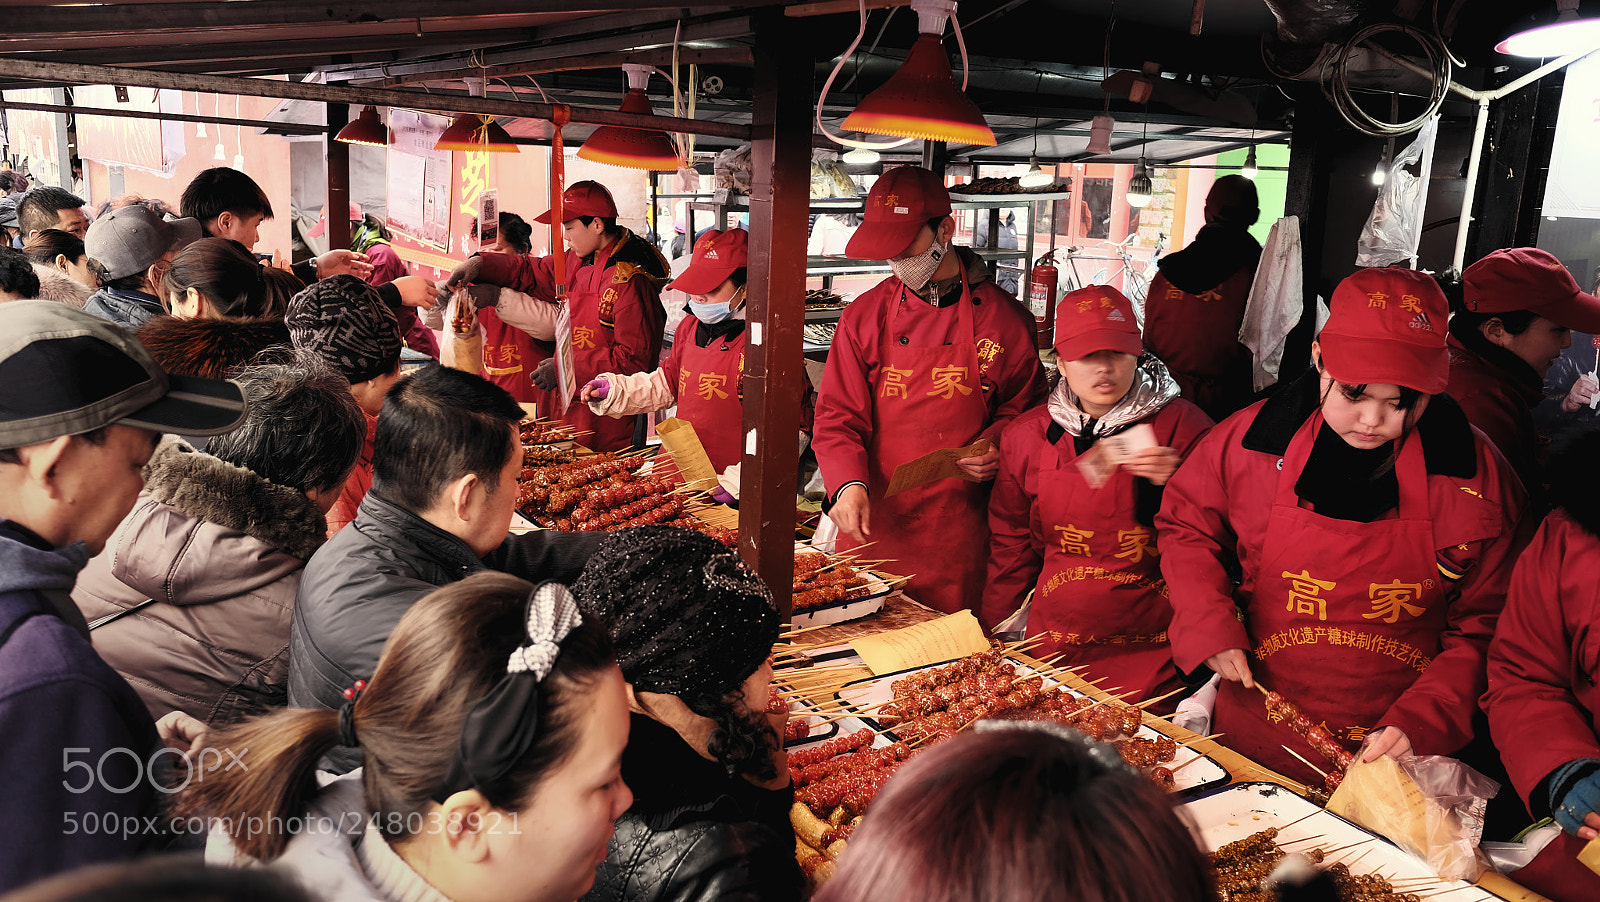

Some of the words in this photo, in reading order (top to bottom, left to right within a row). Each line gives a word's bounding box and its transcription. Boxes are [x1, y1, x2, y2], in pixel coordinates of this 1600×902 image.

[1367, 292, 1422, 313] 高家
[881, 363, 973, 400] 高家
[1054, 523, 1159, 563] 高家
[1282, 569, 1427, 624] 高家
